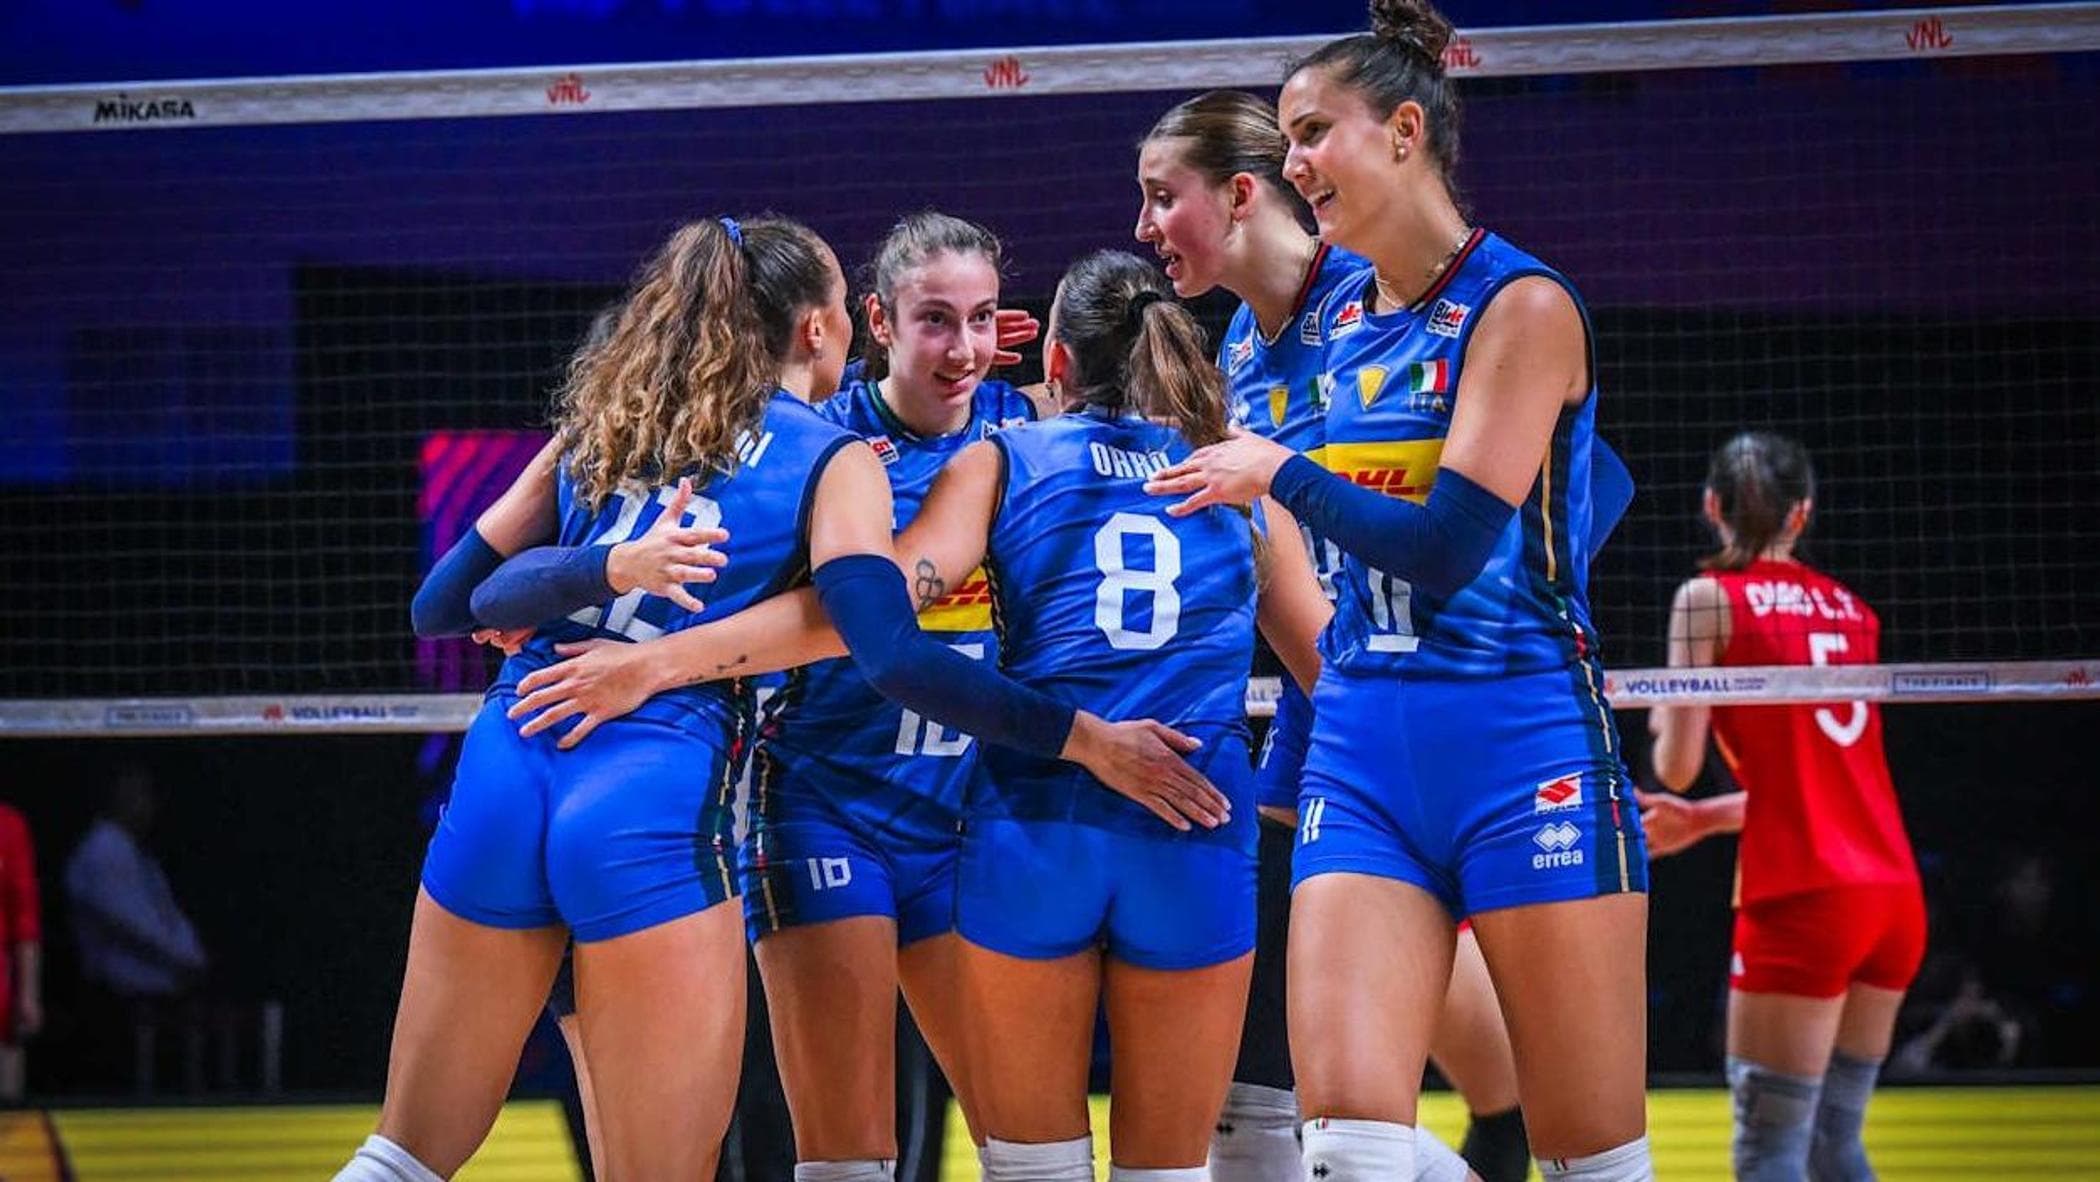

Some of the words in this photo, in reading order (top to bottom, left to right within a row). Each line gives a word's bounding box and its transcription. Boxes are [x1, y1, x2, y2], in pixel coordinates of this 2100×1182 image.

[1095, 512, 1181, 650] 8
[1626, 678, 1730, 694] VOLLEYBALL
[1808, 632, 1868, 748] 5
[1302, 797, 1325, 845] 11
